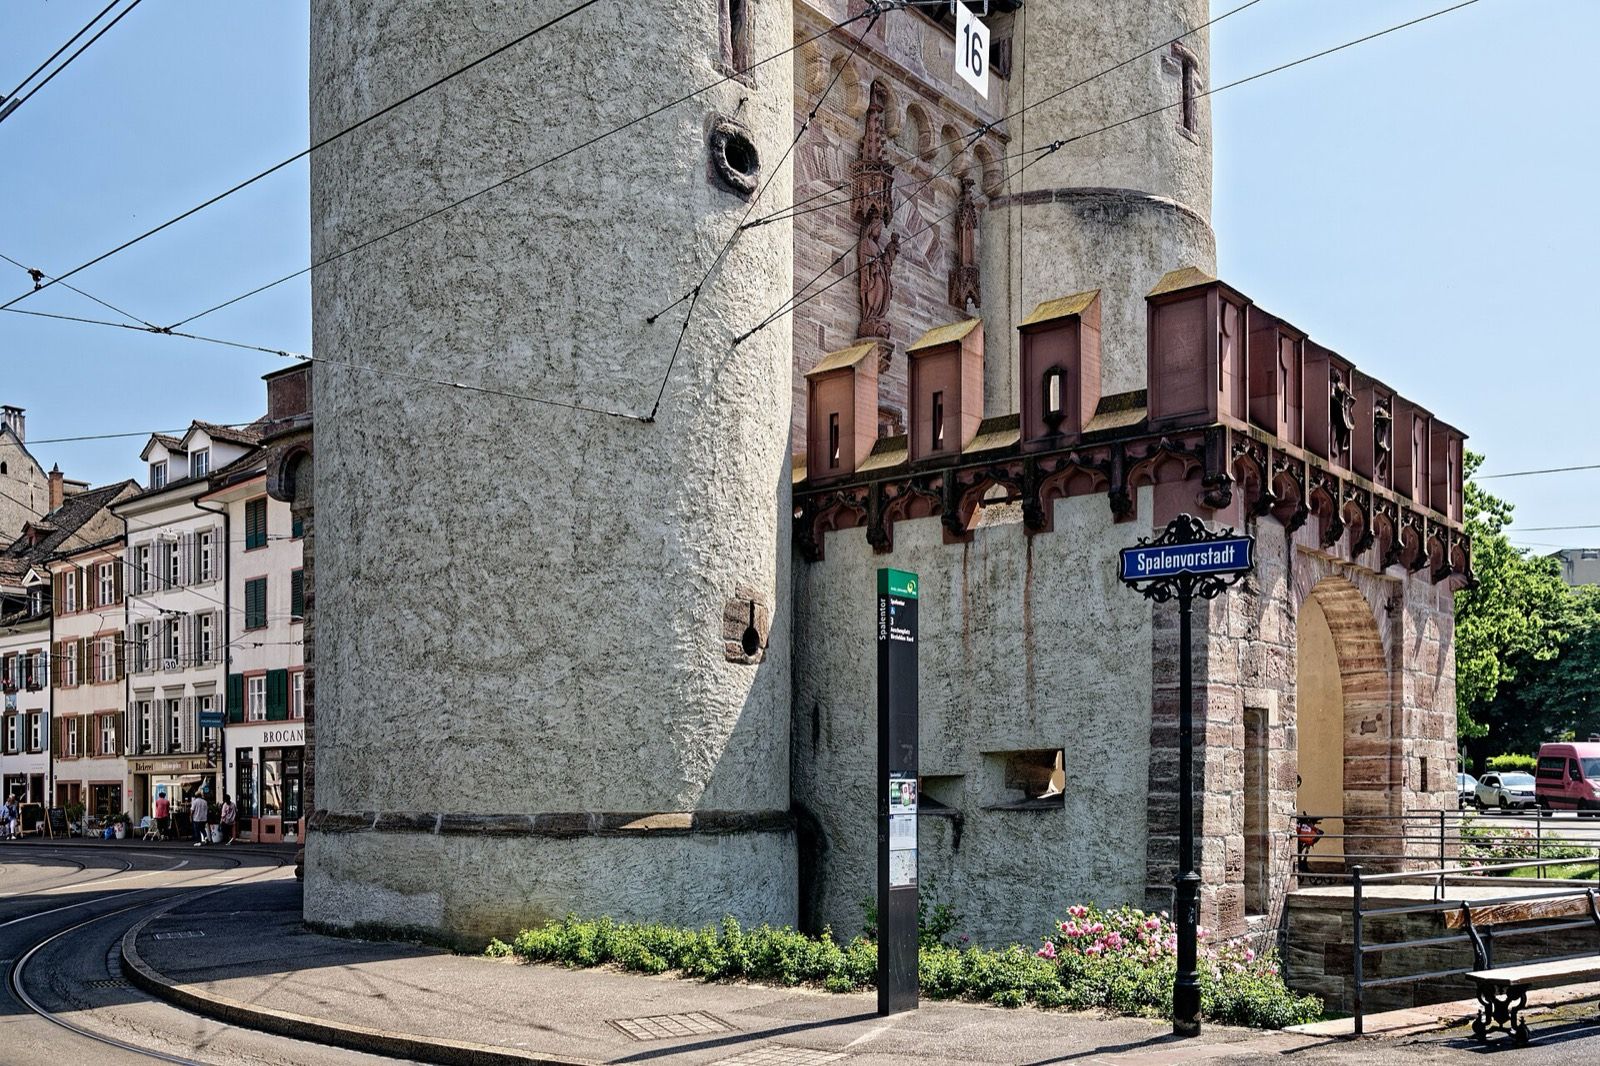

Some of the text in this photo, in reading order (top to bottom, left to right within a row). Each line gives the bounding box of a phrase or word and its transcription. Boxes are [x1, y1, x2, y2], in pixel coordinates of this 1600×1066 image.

[963, 23, 983, 78] 16
[1137, 544, 1235, 575] Spalenvorstadt
[878, 598, 887, 641] Spalentor
[165, 660, 176, 670] 30
[263, 729, 304, 743] BROCAN
